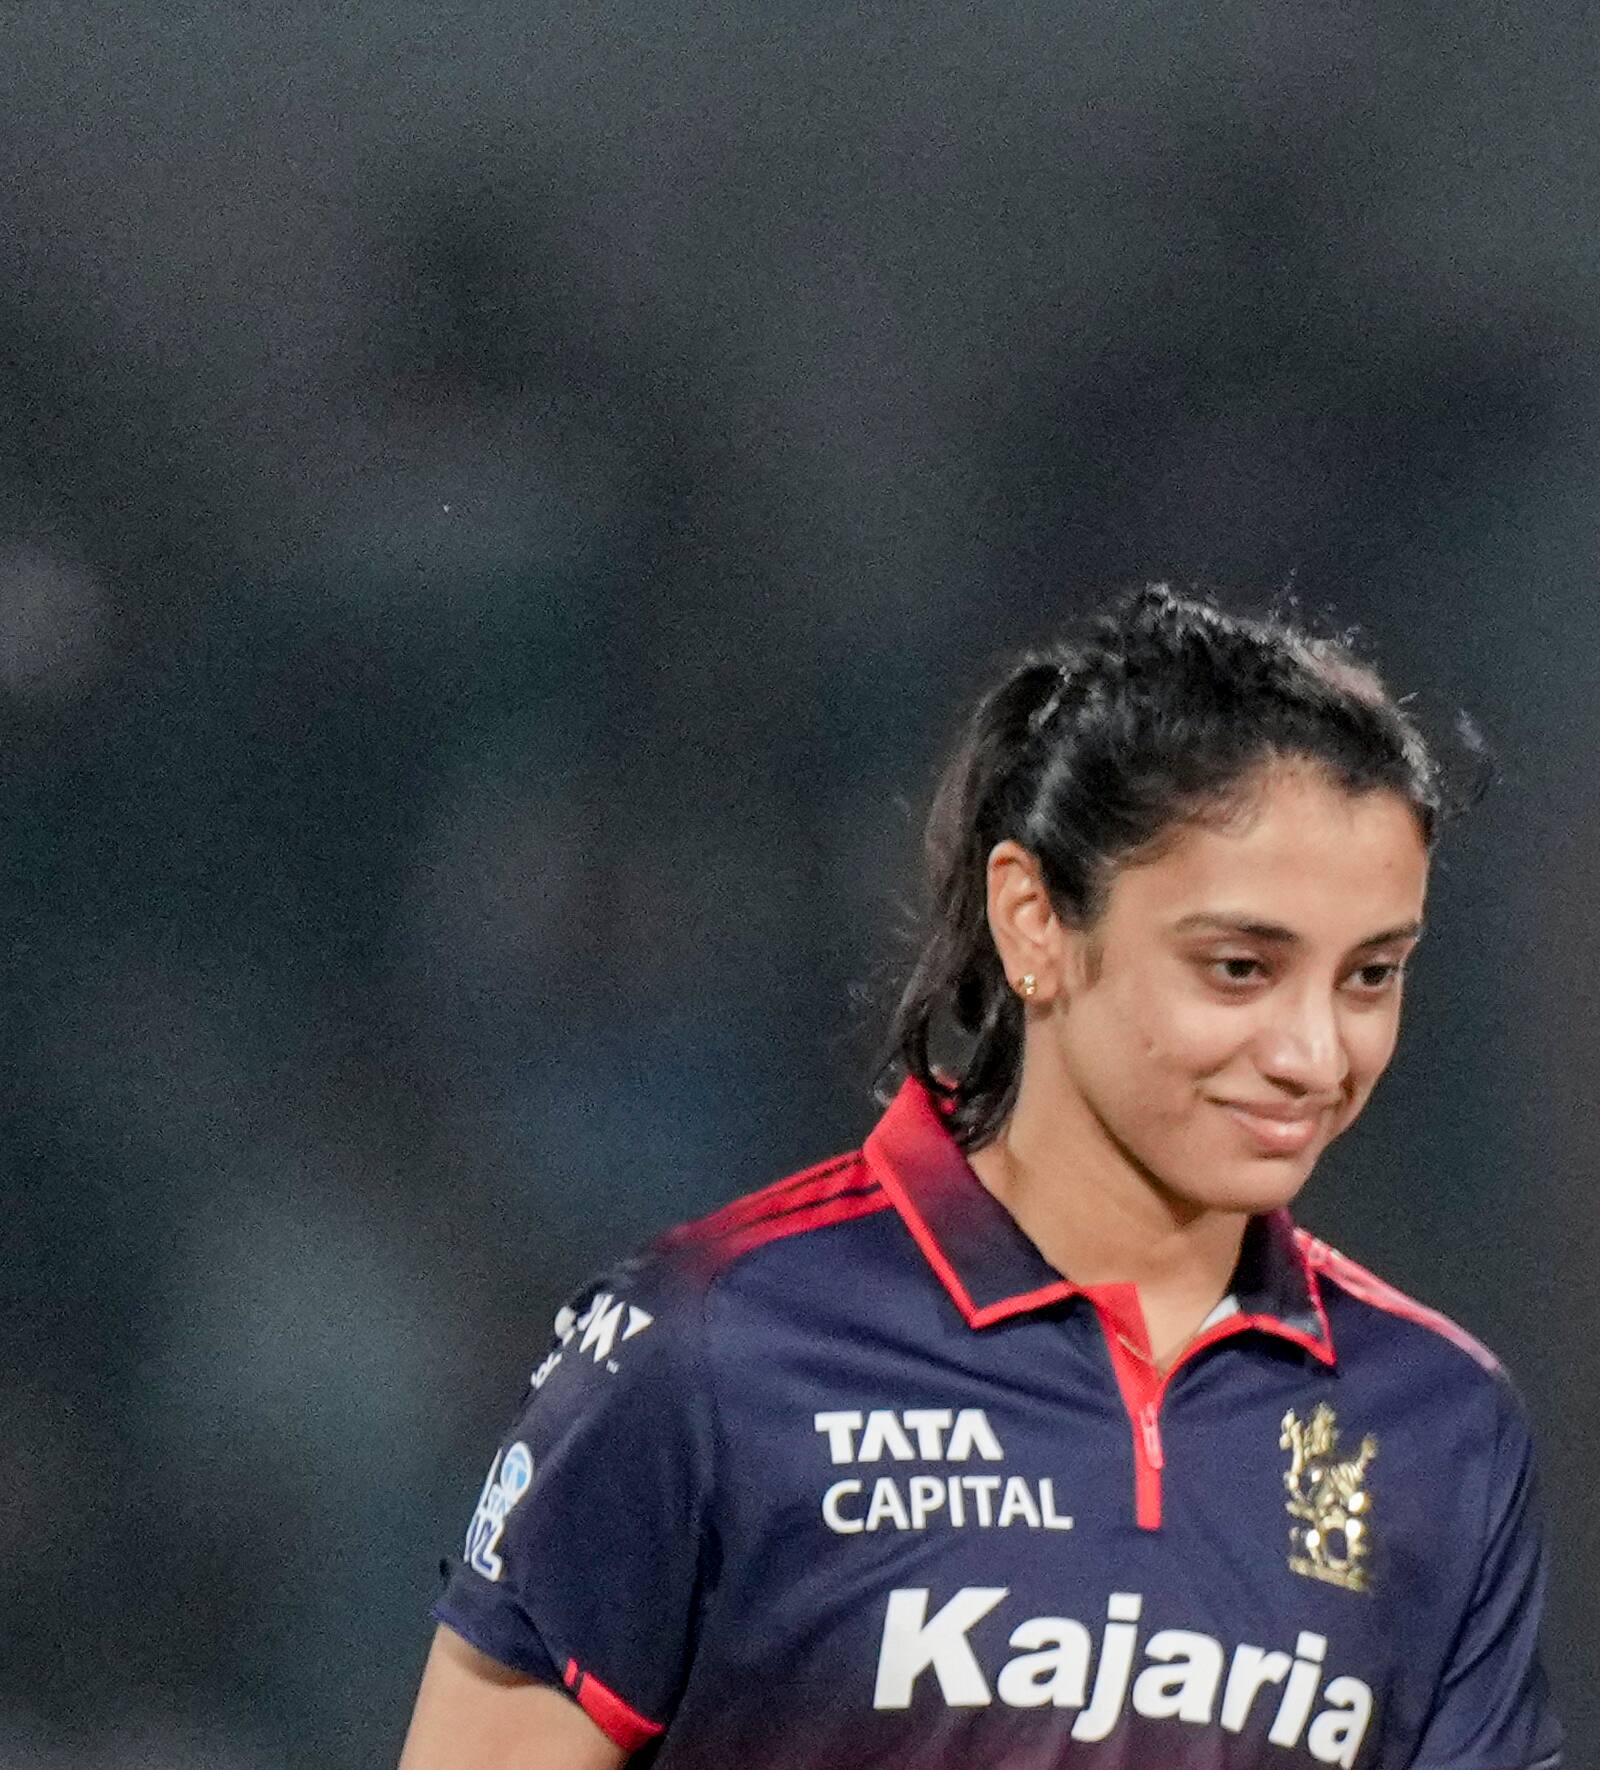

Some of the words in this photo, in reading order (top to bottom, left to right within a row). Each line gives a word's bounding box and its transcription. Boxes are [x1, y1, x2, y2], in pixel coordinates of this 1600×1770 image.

[814, 1409, 1004, 1464] TATA
[822, 1475, 1074, 1534] CAPITAL
[873, 1587, 1374, 1770] Kajaria
